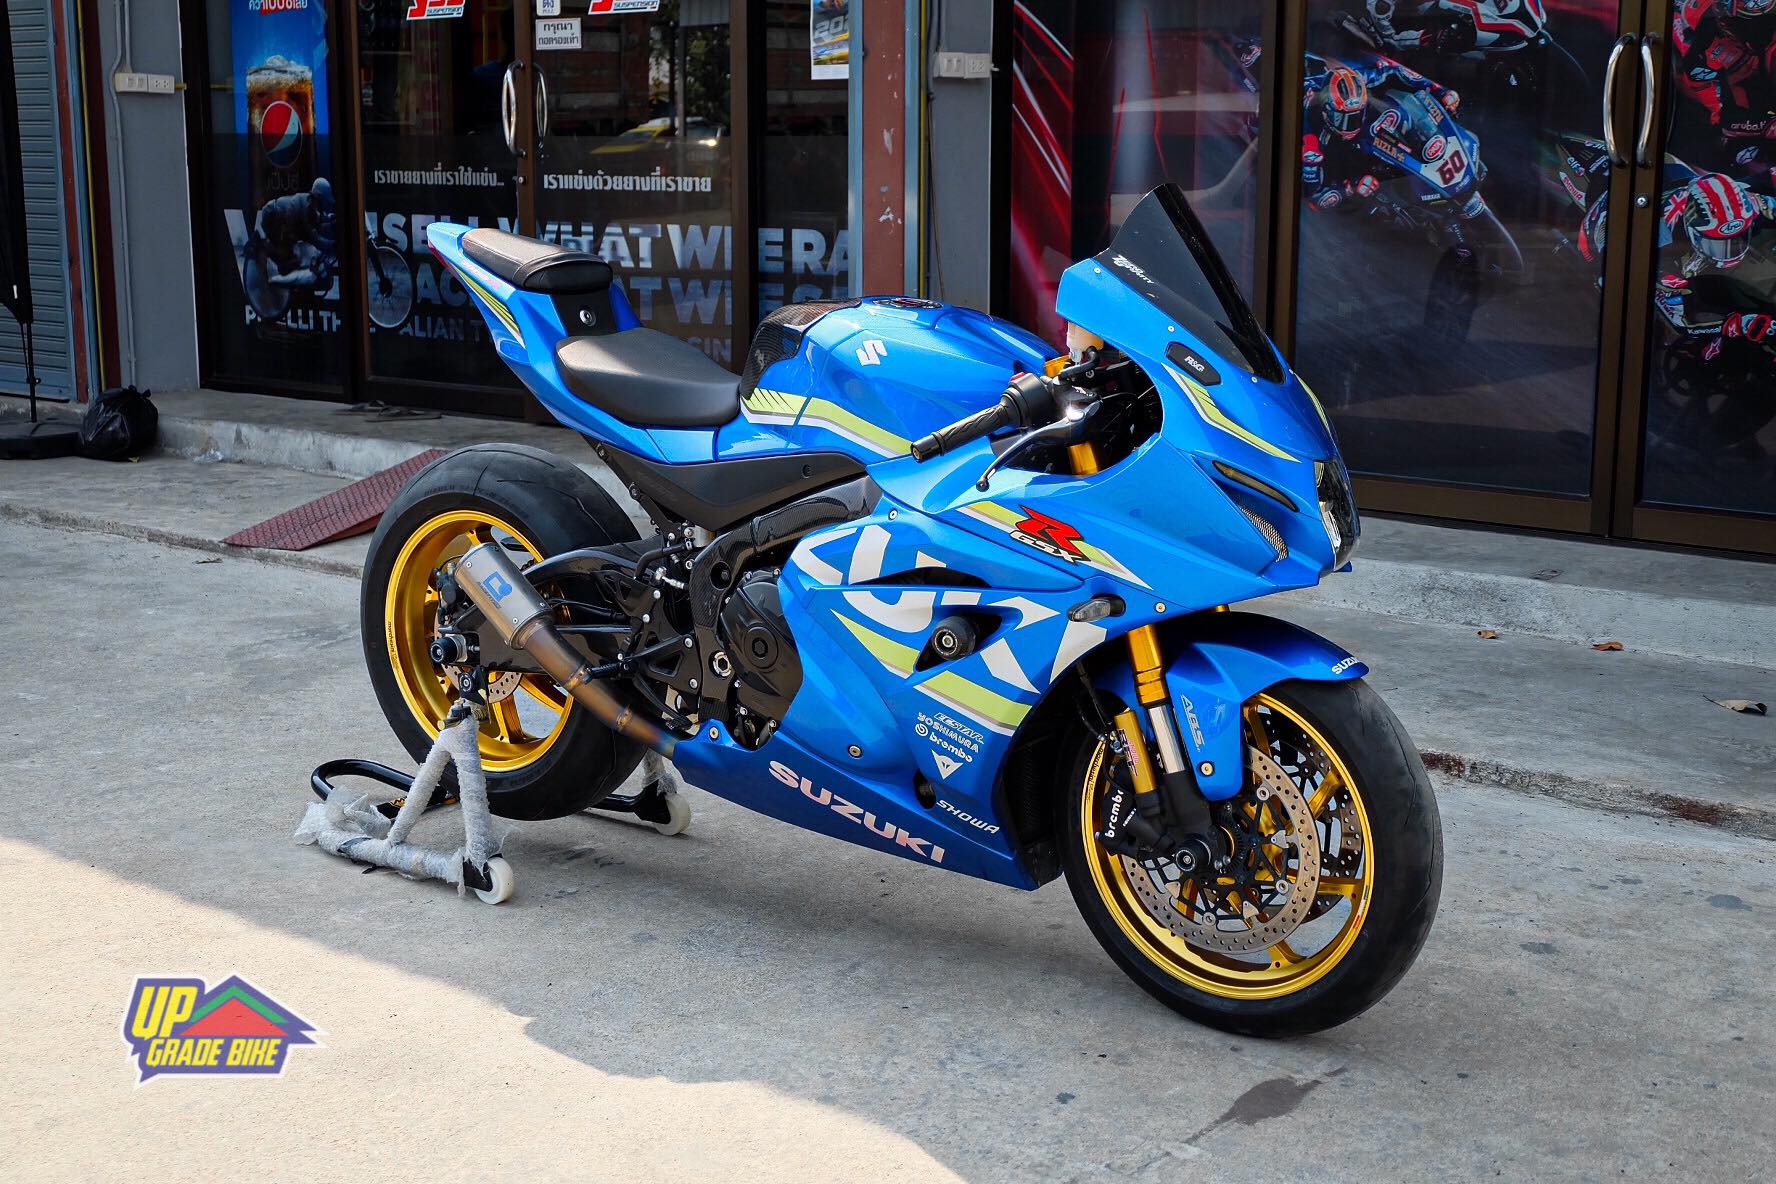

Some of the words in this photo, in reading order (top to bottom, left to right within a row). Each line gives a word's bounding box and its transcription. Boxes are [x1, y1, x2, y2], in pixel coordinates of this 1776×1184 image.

[1436, 150, 1466, 186] 60
[1184, 355, 1205, 372] R&G
[917, 711, 979, 753] YOSHIMURA
[929, 732, 973, 763] brembo
[768, 760, 945, 864] SUZUKI
[936, 799, 1000, 834] SHOWA
